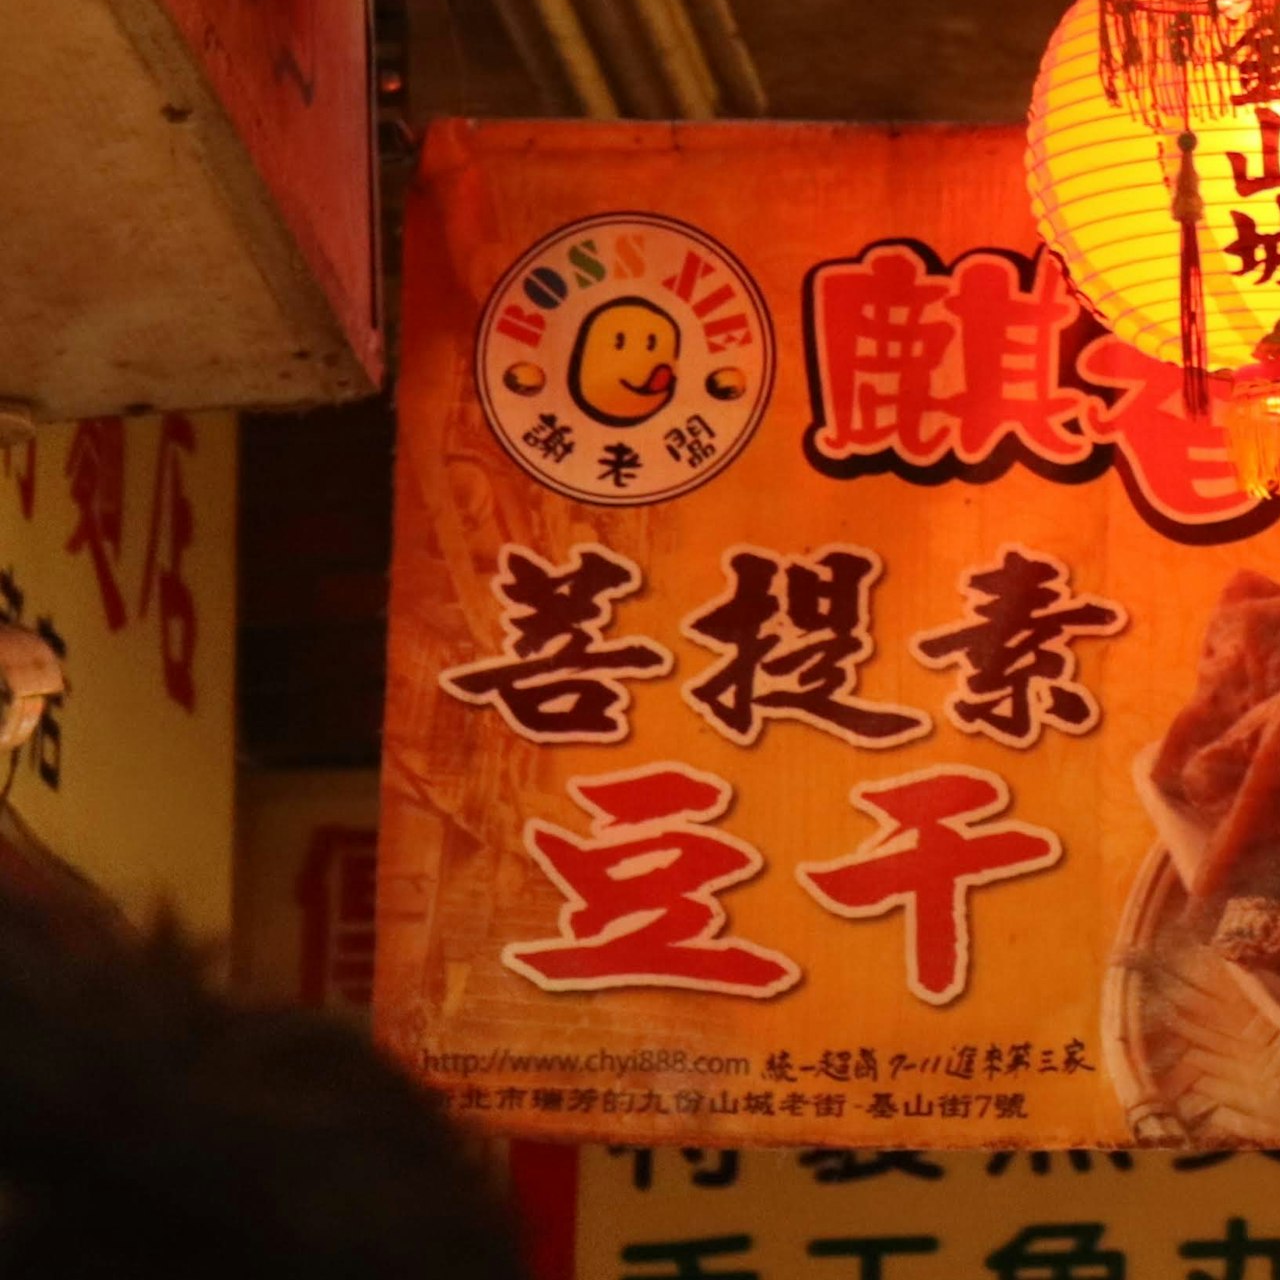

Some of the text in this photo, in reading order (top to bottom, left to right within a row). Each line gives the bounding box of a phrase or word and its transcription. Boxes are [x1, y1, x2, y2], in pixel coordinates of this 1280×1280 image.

[496, 234, 754, 355] BOSS XIE
[521, 413, 717, 488] 謝老闆
[446, 546, 1122, 746] 菩提素
[503, 767, 1058, 1001] 豆干
